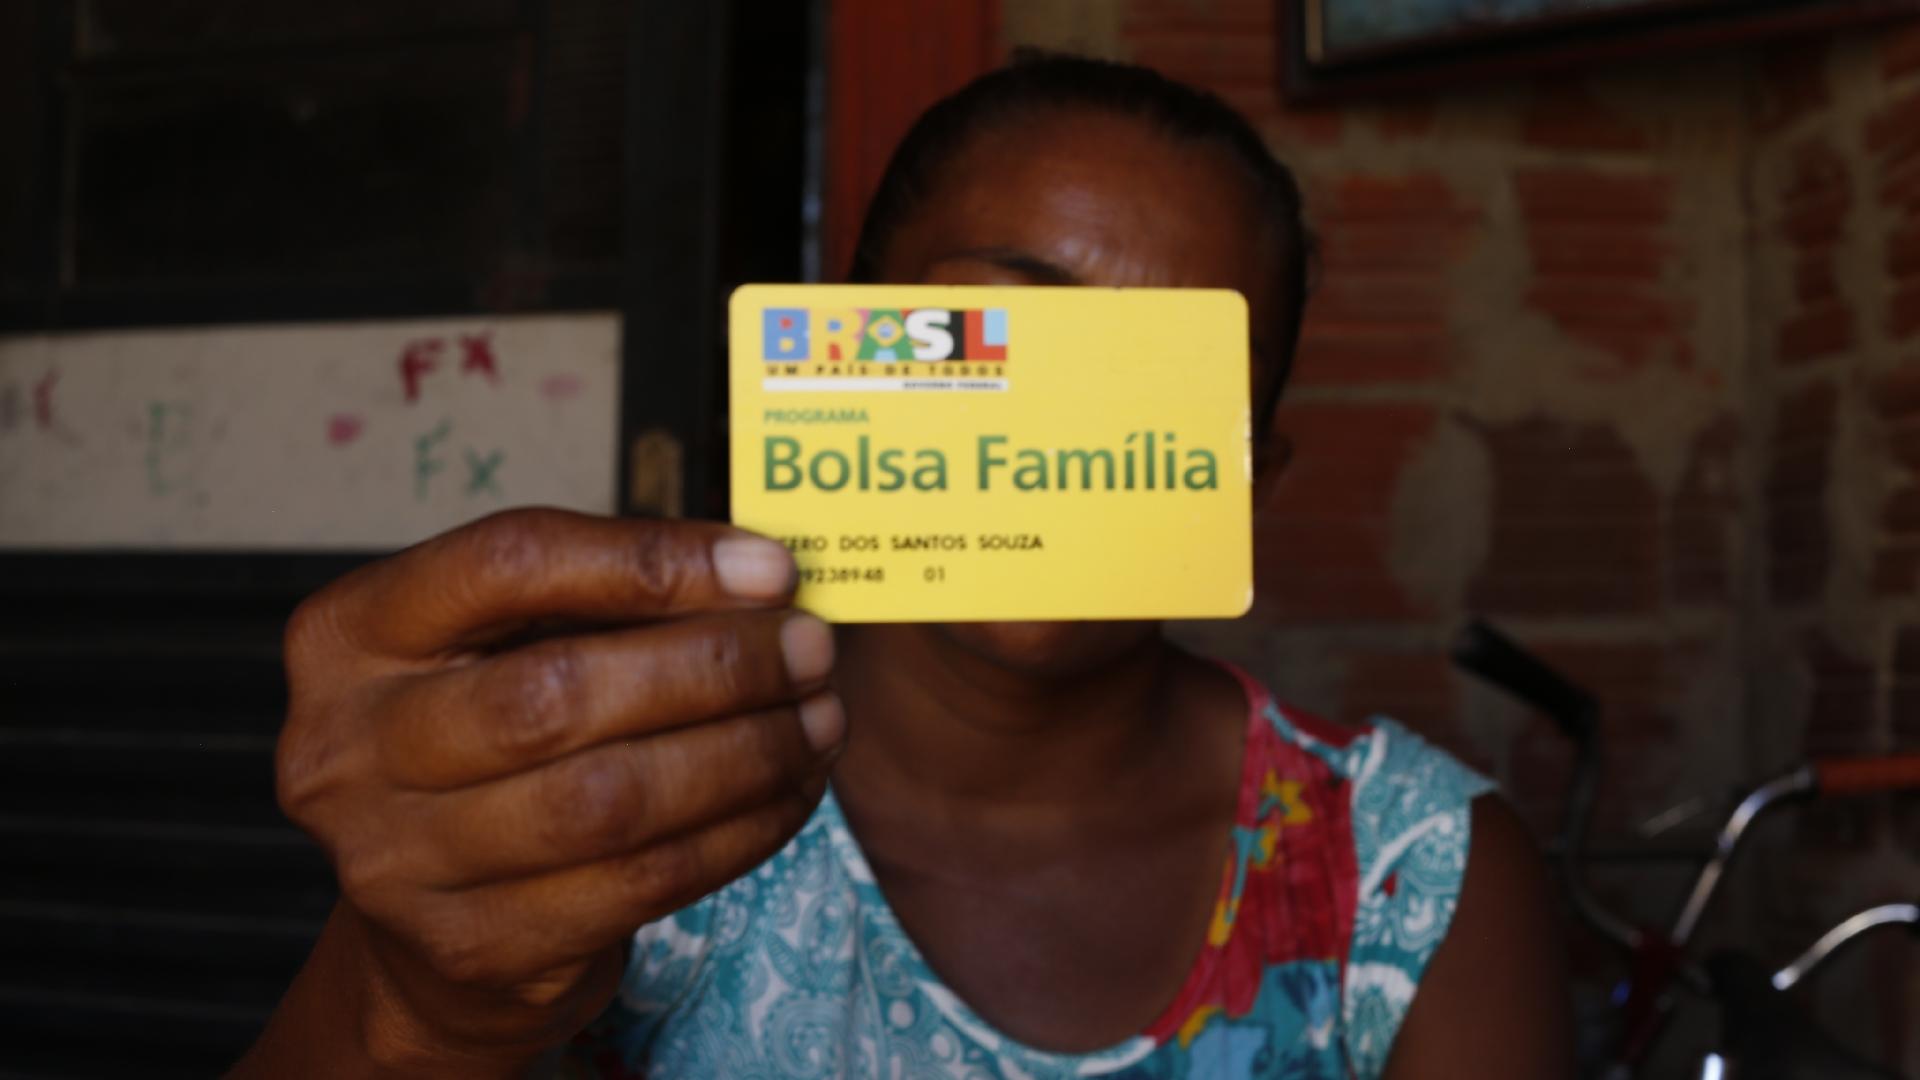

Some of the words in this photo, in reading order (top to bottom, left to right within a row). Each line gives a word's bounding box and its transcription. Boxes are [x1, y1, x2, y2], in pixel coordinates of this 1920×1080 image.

[762, 308, 1007, 361] BRASIL
[767, 364, 800, 376] UM
[884, 363, 911, 376] DE
[928, 363, 1005, 376] TODOS
[763, 409, 870, 424] PROGRAMA
[763, 435, 948, 492] Bolsa
[977, 431, 1220, 491] Família
[839, 535, 879, 551] DOS
[891, 534, 967, 551] SANTOS
[977, 534, 1043, 550] SOUZA
[923, 566, 945, 582] 01
